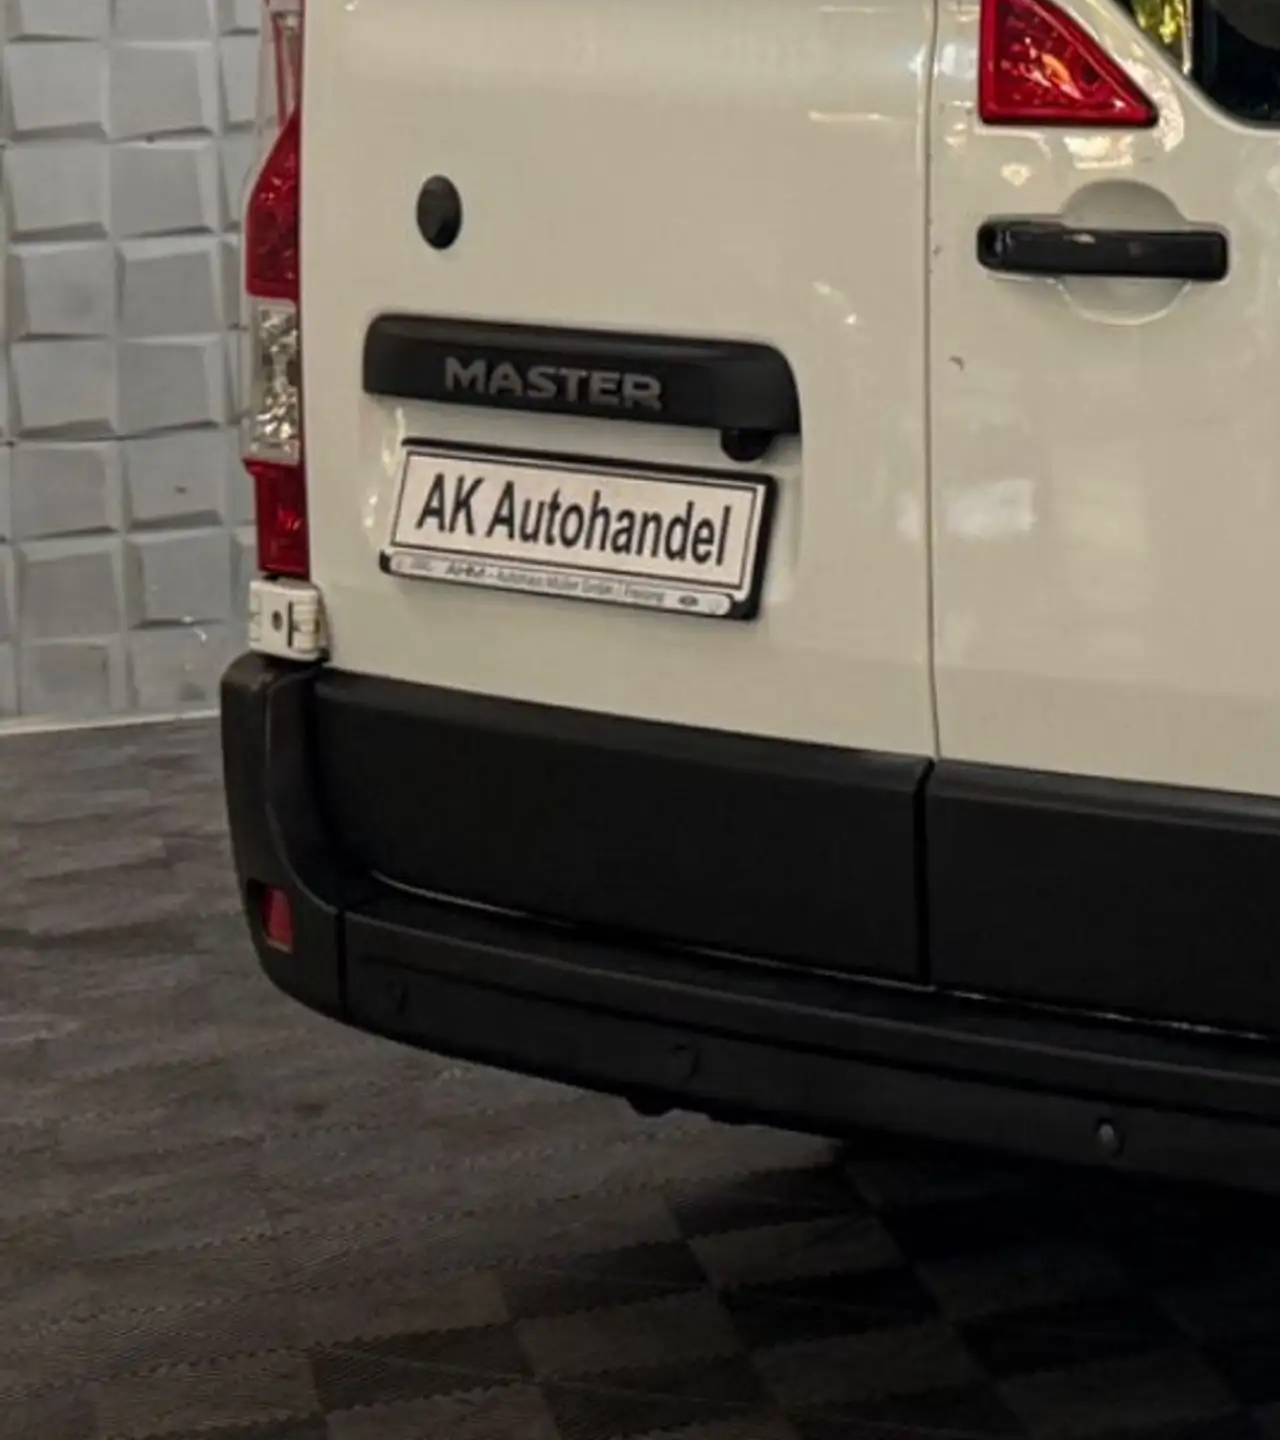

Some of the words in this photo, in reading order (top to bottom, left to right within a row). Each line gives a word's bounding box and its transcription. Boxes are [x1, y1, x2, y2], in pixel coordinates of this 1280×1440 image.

[445, 357, 662, 410] MASTER
[415, 473, 484, 536] AK
[488, 481, 731, 566] Autohandel
